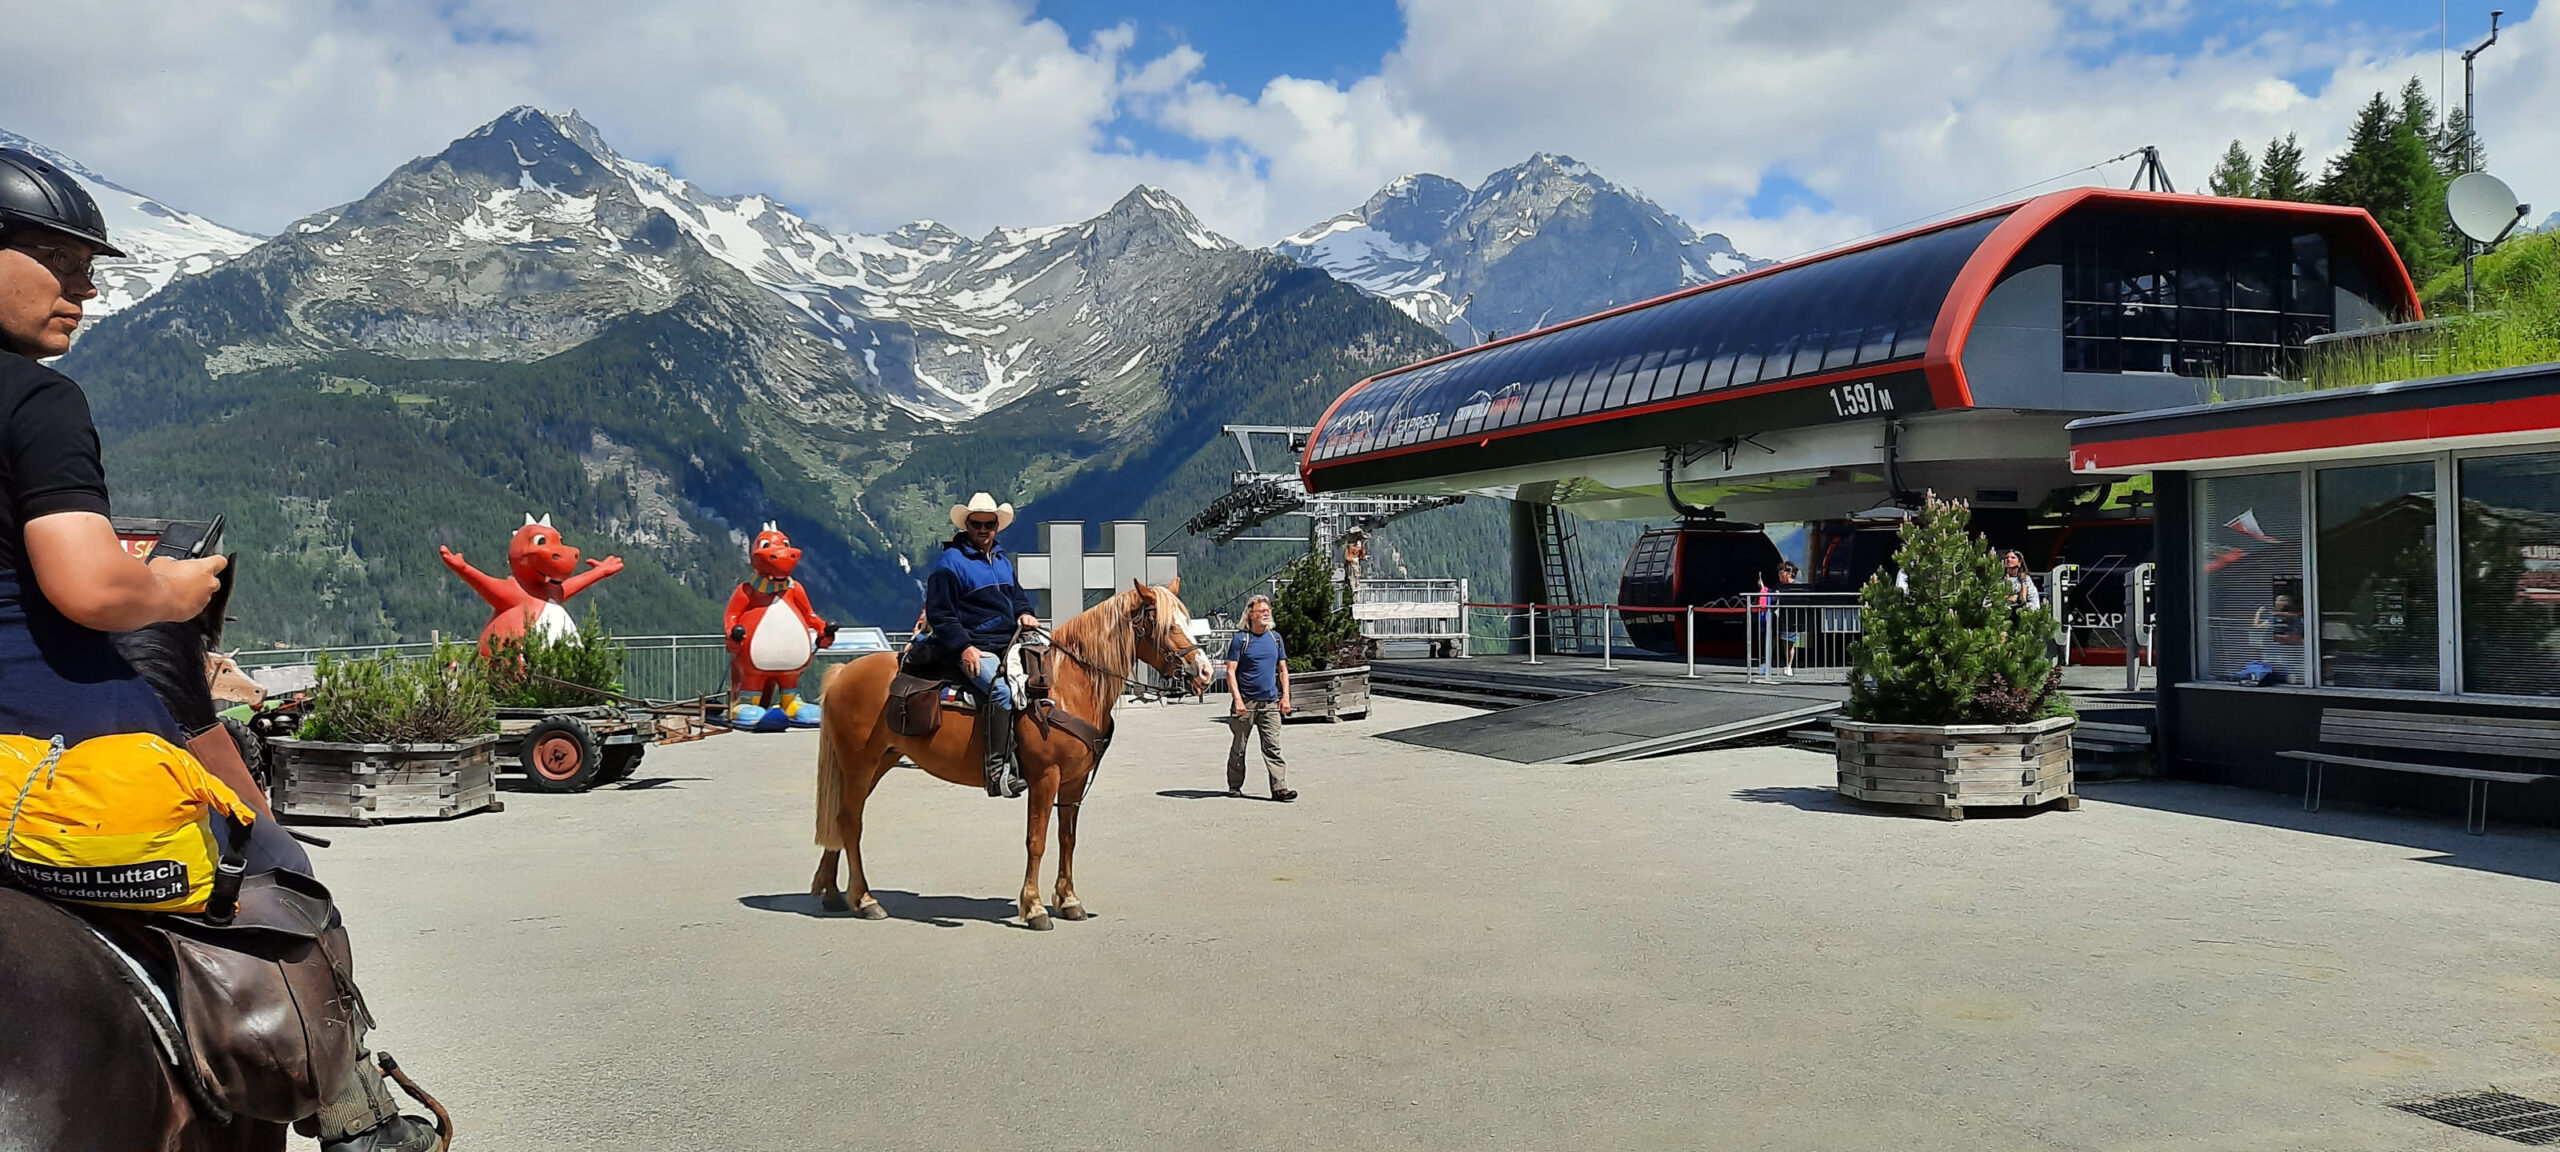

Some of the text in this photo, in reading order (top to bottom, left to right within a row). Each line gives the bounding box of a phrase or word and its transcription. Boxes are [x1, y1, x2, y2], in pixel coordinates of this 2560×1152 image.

[1830, 382, 1894, 416] 1.597 M
[1396, 413, 1441, 434] EXPRESS
[2085, 612, 2127, 628] EXP
[97, 861, 182, 884] Luttach
